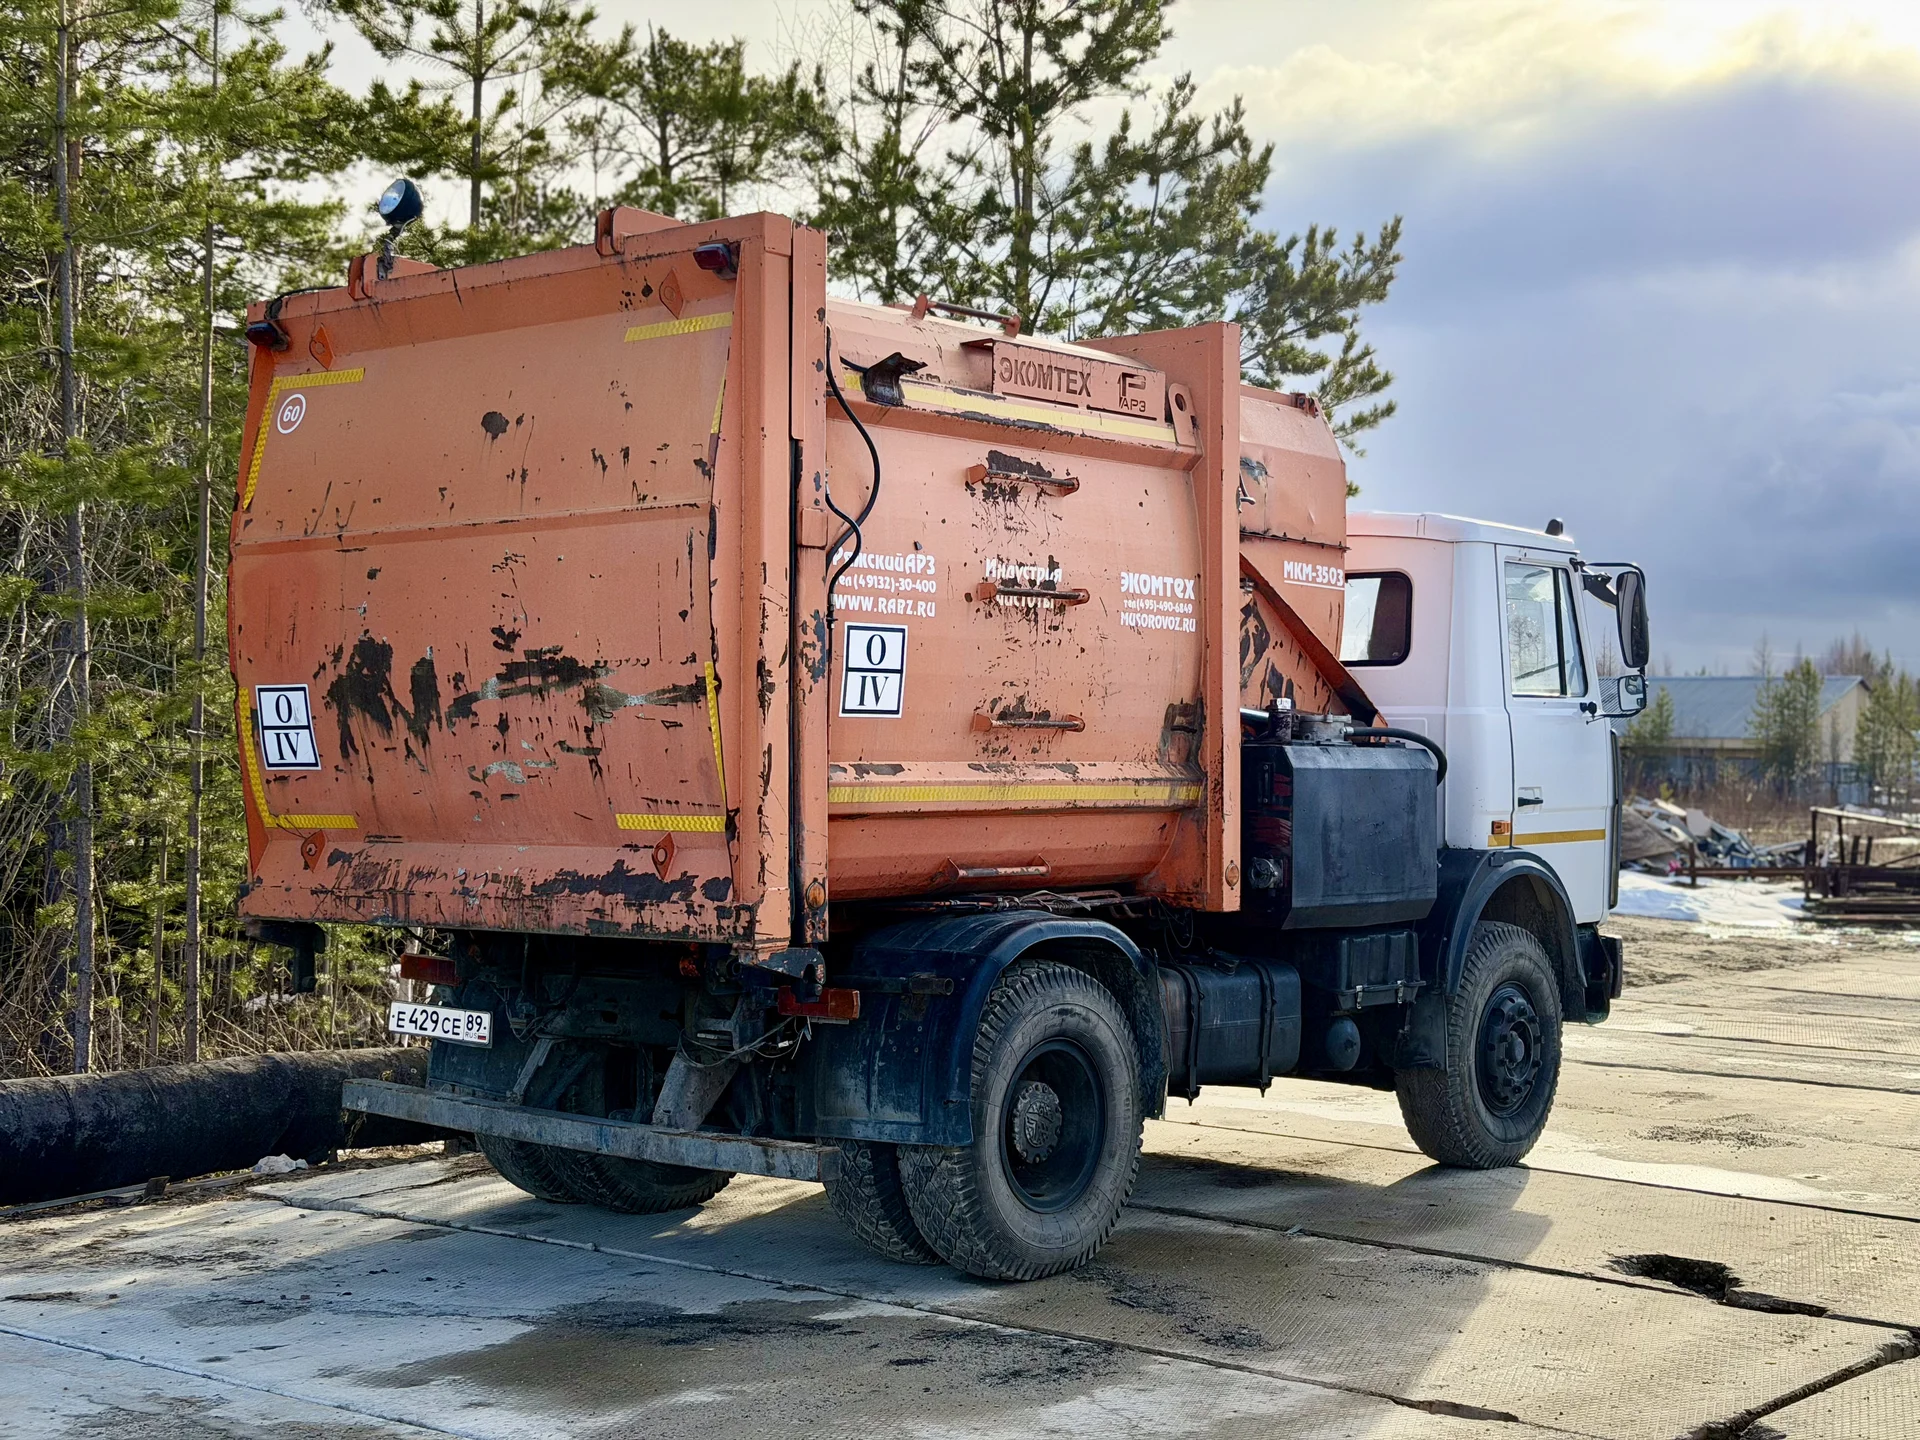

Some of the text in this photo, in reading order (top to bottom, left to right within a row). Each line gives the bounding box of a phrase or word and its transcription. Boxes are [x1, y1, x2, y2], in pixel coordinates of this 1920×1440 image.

[999, 357, 1092, 398] ЭКОМТЕХ
[282, 405, 301, 422] 60
[1120, 611, 1197, 633] MUSOROVOZ.RU
[857, 675, 890, 707] IV
[273, 732, 301, 761] IV
[464, 1031, 478, 1039] RUS
